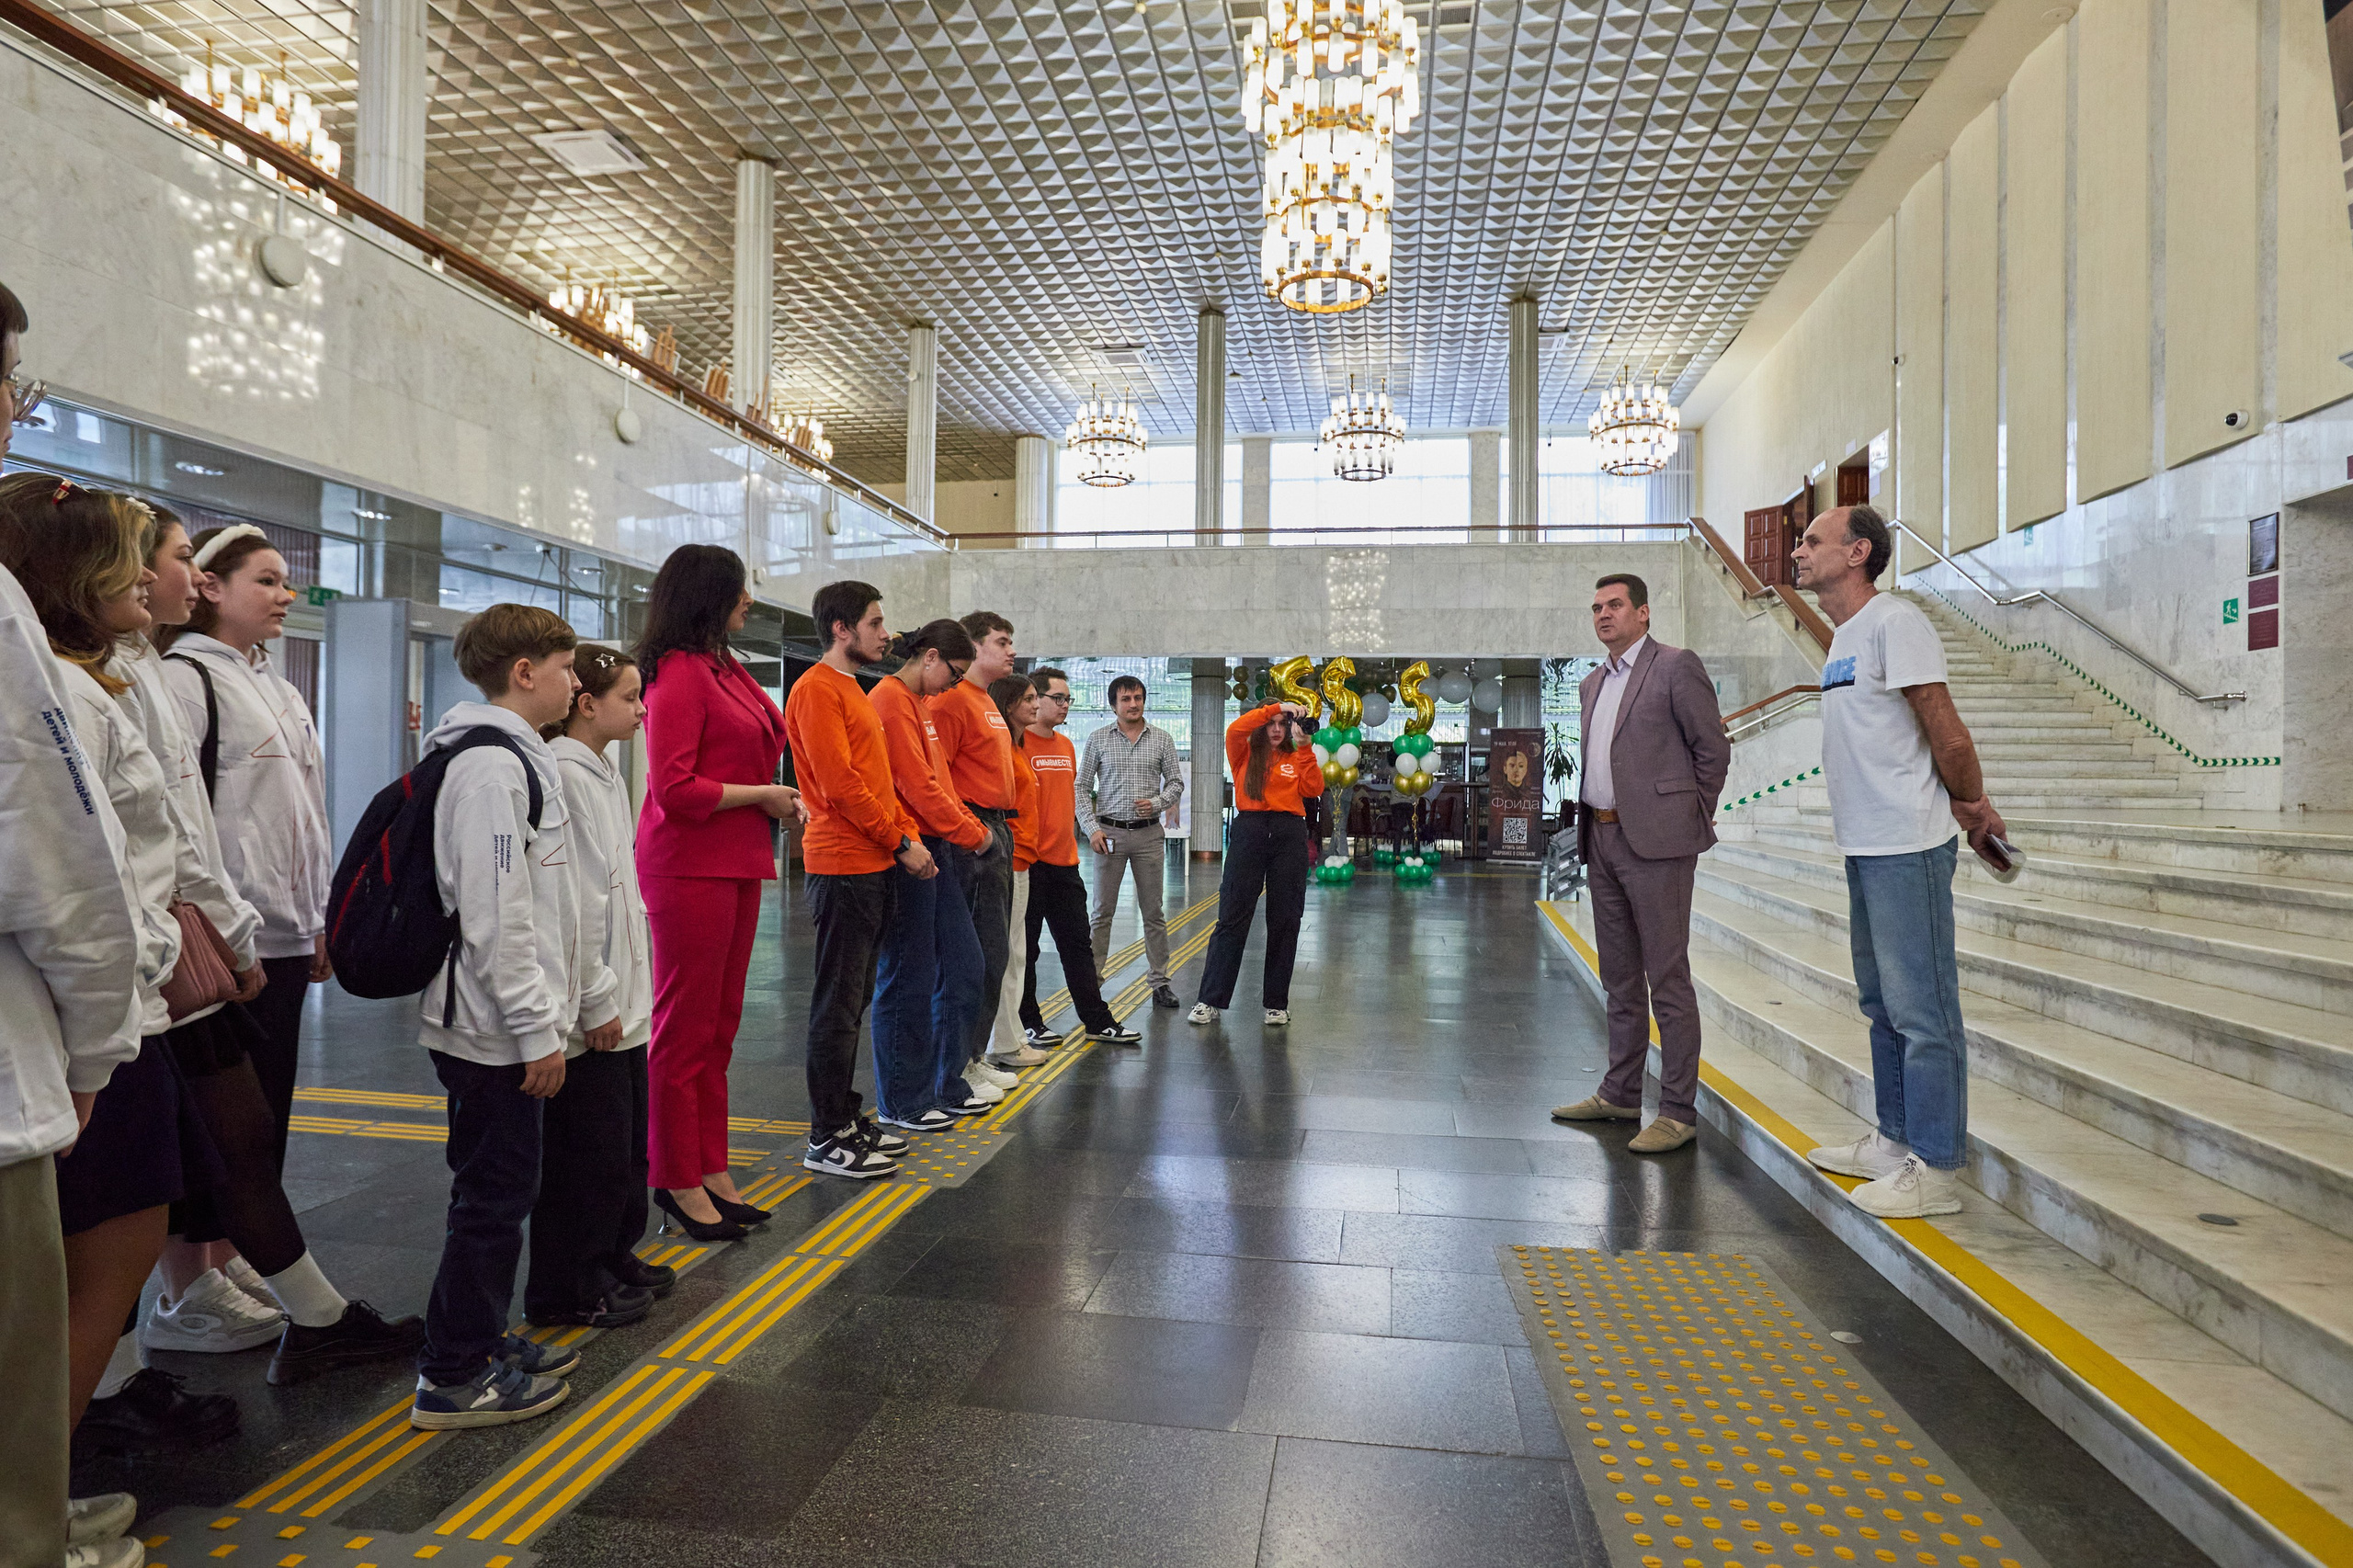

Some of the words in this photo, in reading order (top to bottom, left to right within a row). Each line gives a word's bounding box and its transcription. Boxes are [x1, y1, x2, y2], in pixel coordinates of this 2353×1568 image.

[41, 710, 66, 744] детей
[60, 746, 70, 755] и
[1036, 758, 1072, 767] #МЫВМЕСТЕ
[64, 757, 94, 815] молодёжи
[1492, 797, 1540, 811] Фрида
